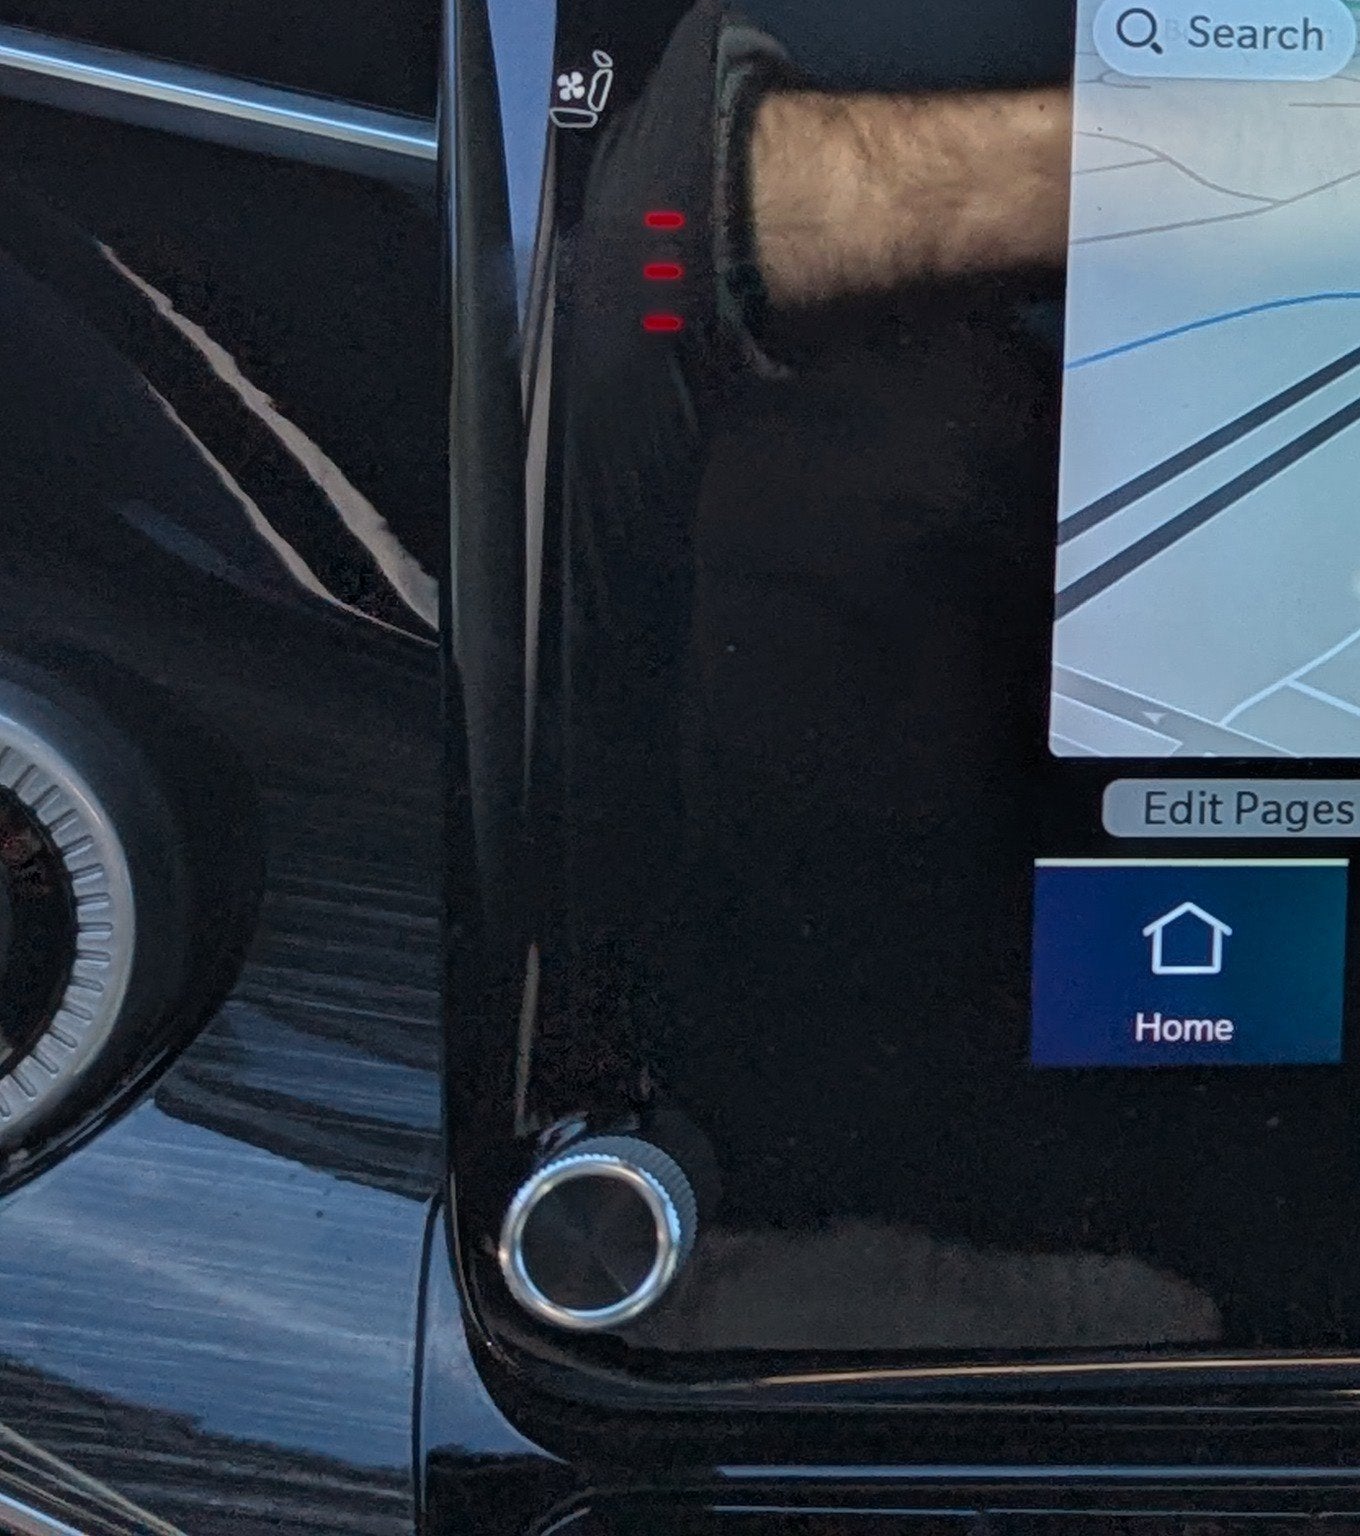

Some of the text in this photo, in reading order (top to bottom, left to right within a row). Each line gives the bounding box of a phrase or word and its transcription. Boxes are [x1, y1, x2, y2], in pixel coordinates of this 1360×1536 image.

[1188, 15, 1324, 52] Search
[1144, 790, 1354, 833] Edit Pages
[1134, 1011, 1234, 1042] Home
